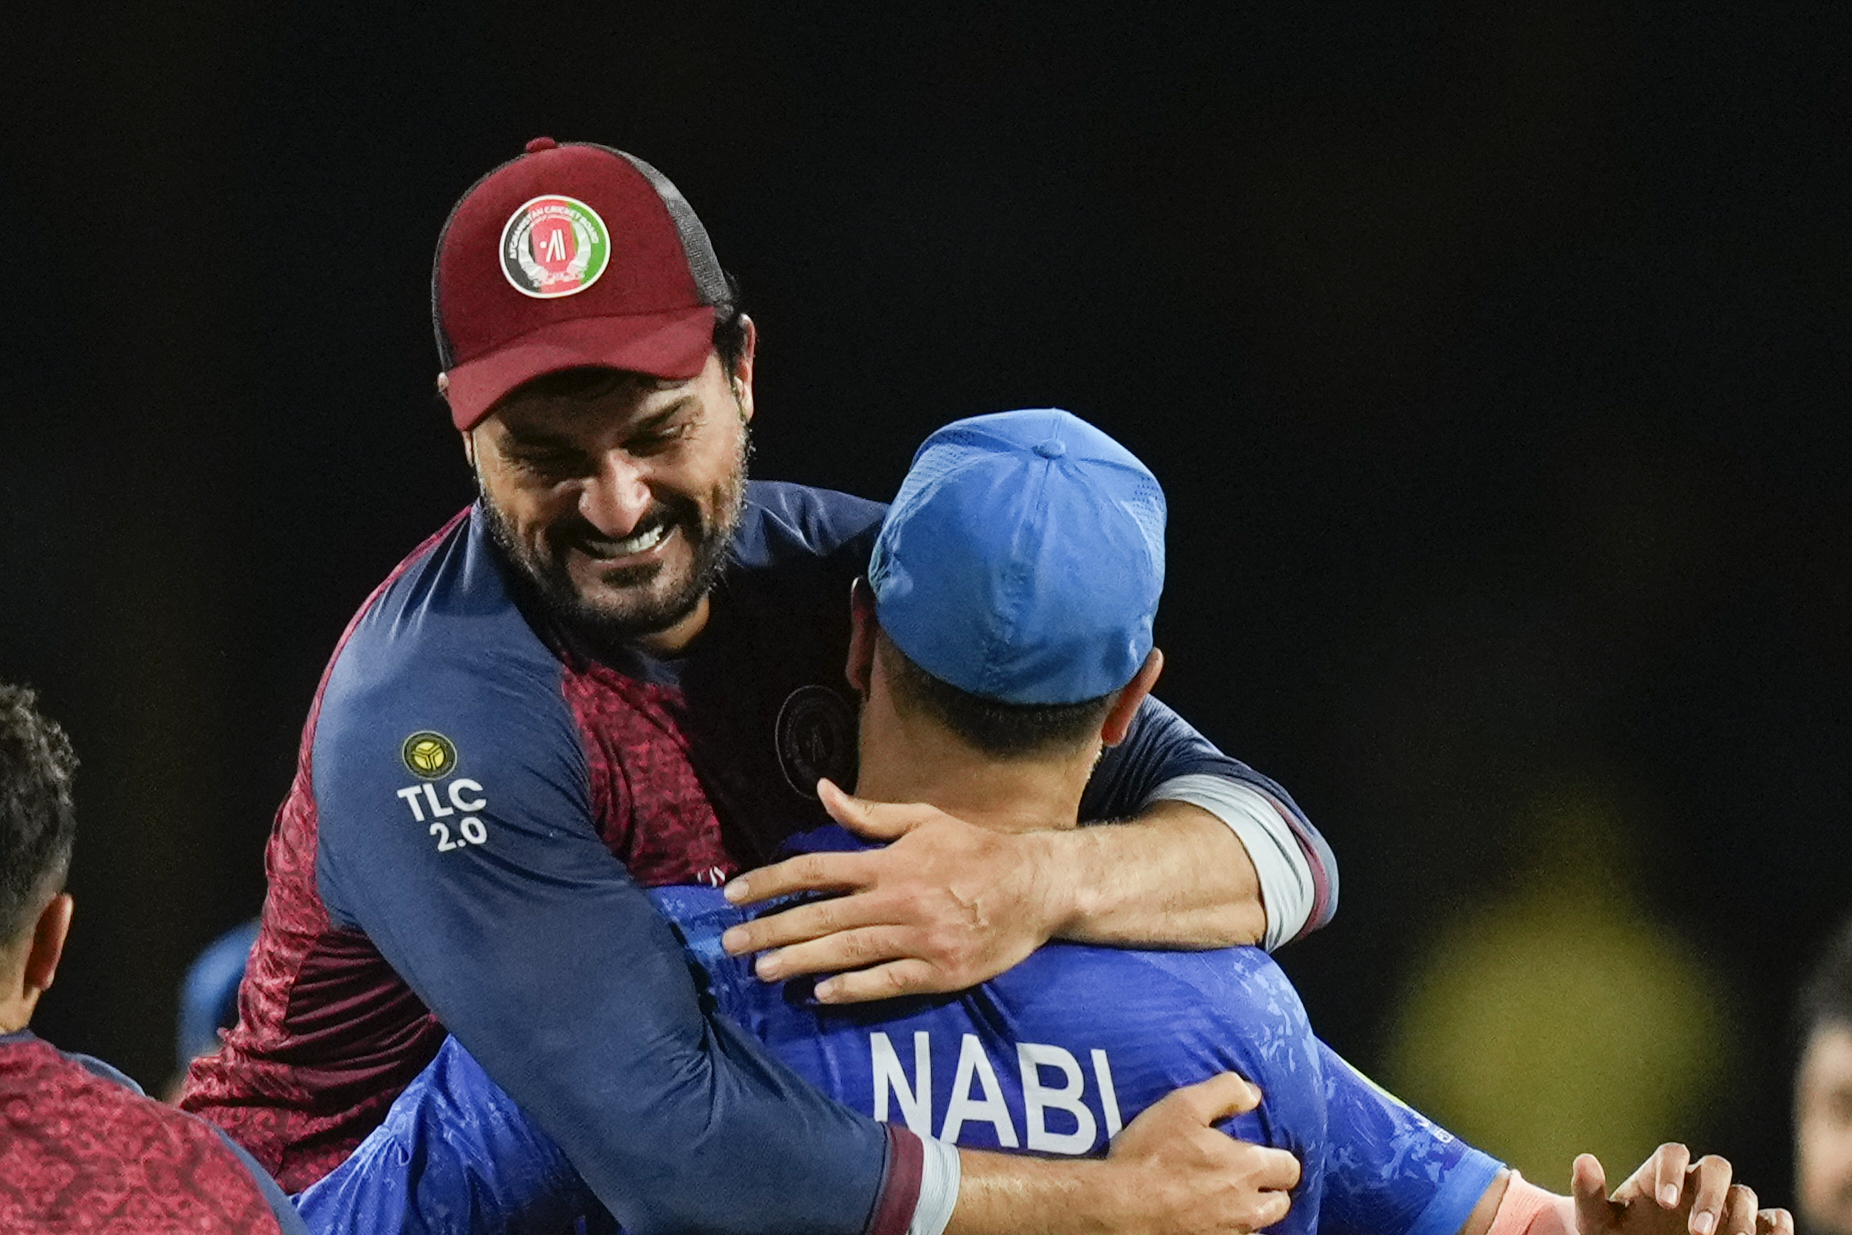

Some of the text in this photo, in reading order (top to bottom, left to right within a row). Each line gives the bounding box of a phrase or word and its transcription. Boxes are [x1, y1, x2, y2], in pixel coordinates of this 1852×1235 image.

[397, 778, 487, 822] TLC
[430, 816, 488, 852] 2.0
[870, 1030, 1124, 1156] NABI
